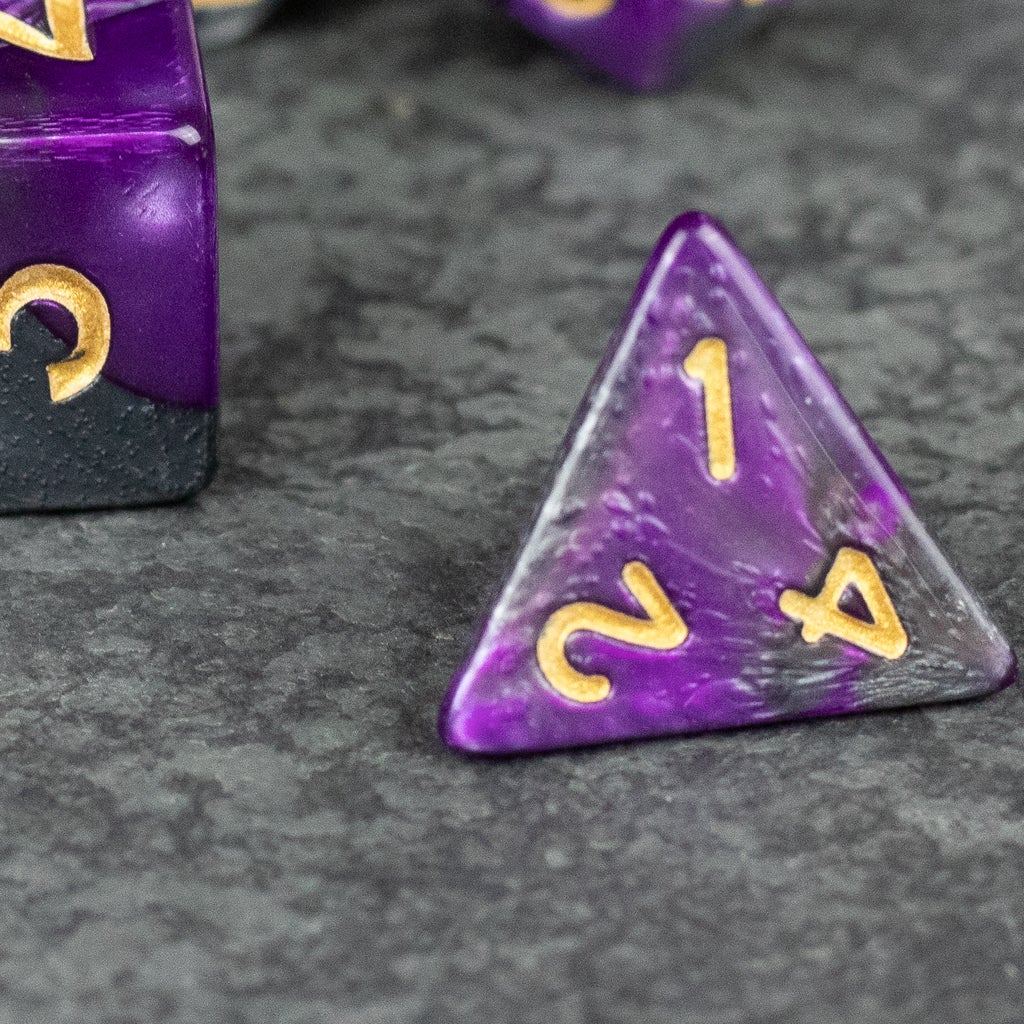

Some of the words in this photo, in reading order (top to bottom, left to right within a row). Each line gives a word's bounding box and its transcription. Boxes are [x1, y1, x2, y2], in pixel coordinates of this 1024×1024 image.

[684, 338, 736, 481] 1
[536, 561, 689, 704] 2
[779, 546, 909, 660] 4
